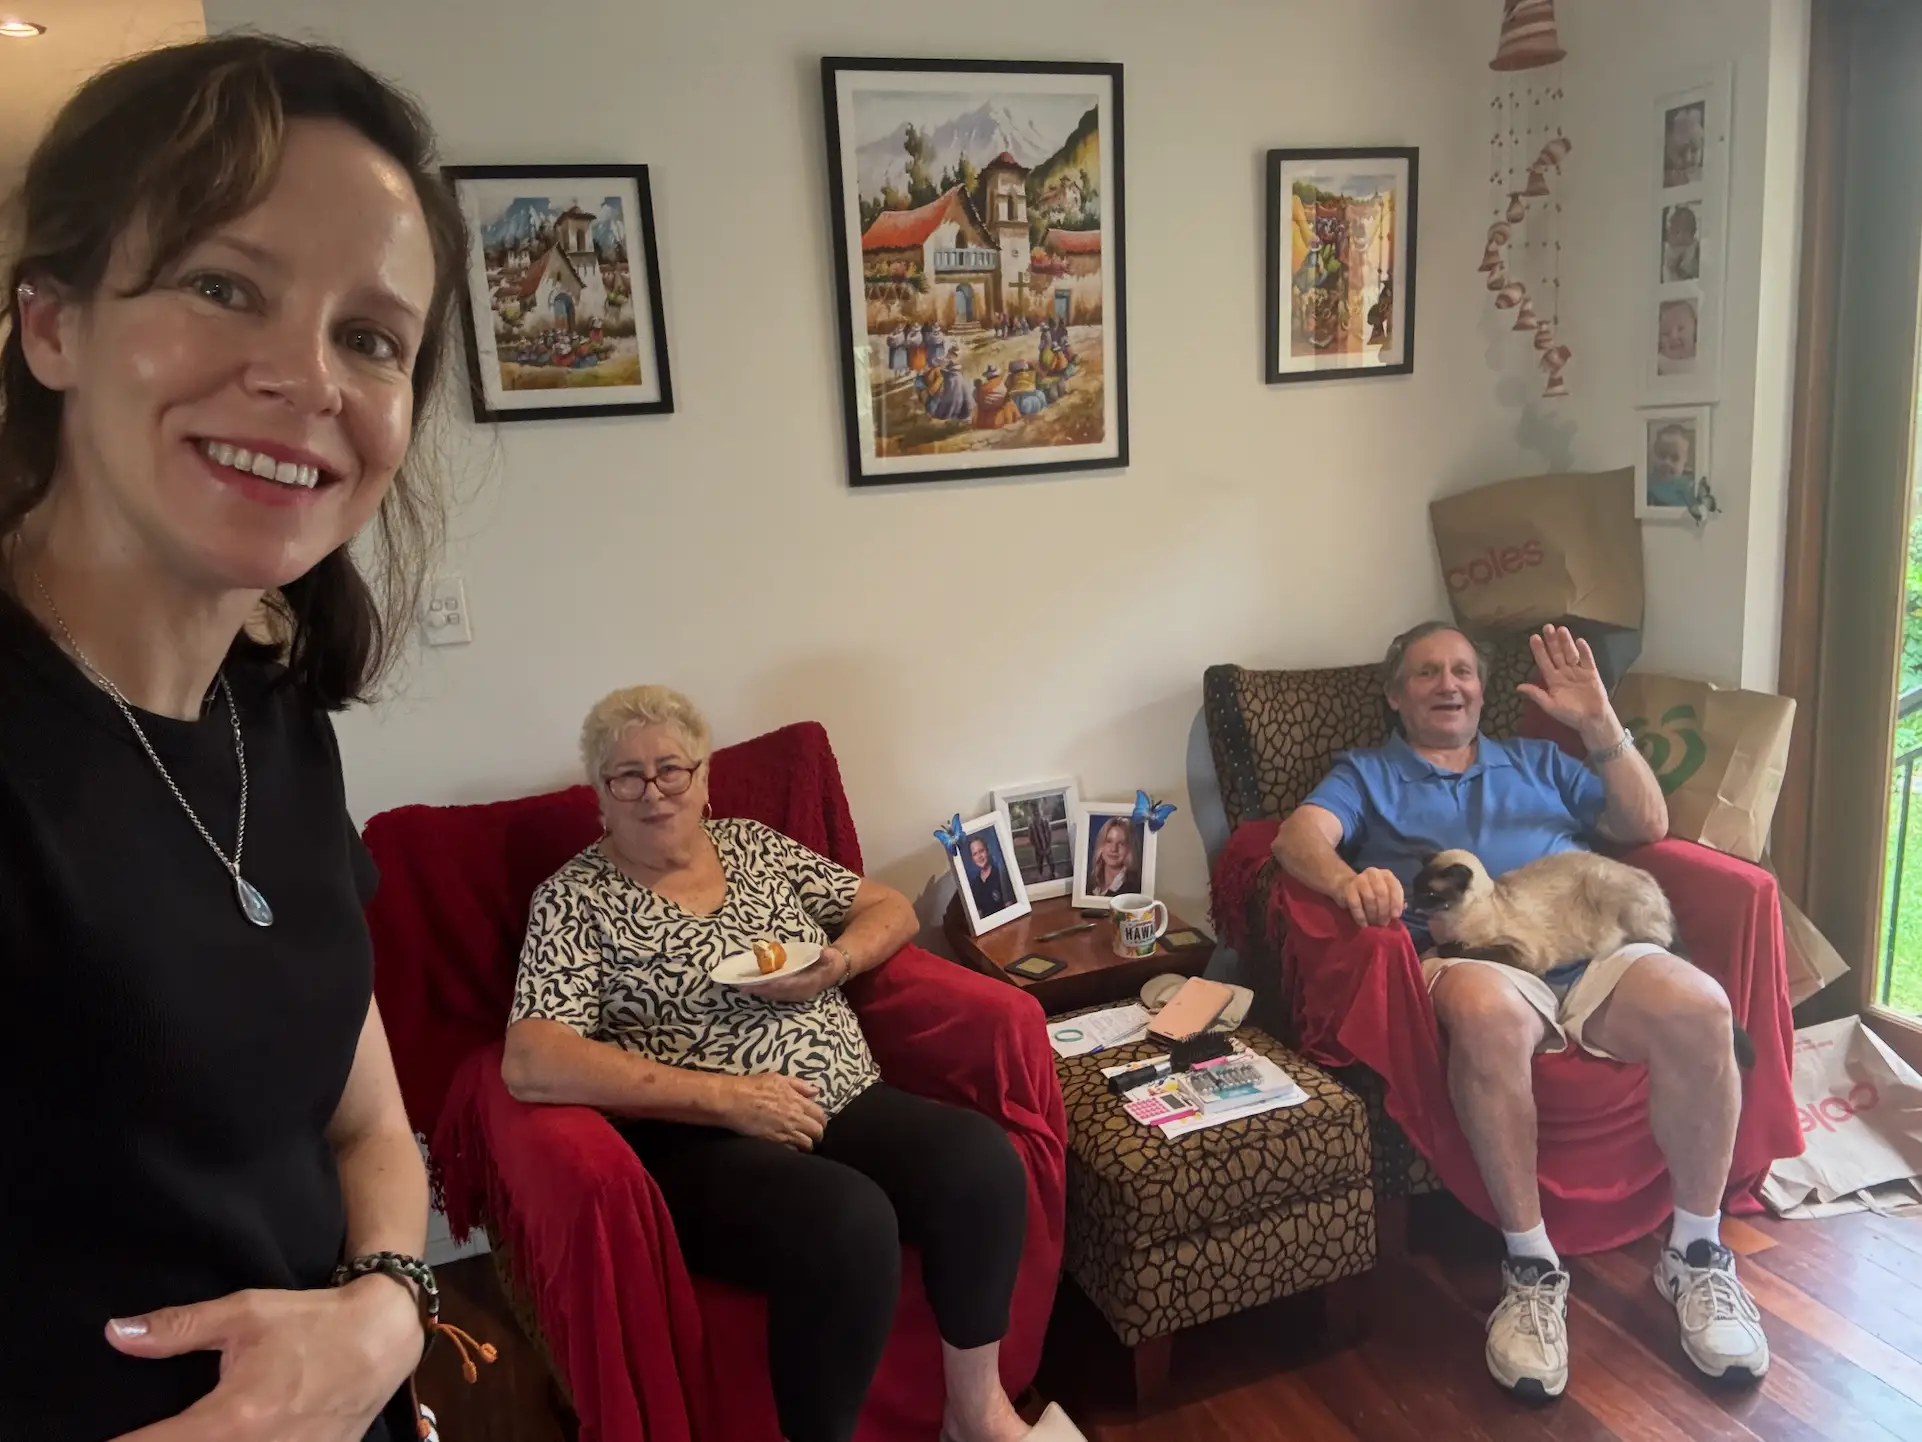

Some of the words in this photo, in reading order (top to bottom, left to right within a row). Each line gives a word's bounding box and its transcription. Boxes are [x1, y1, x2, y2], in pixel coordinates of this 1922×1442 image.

[1446, 540, 1544, 592] coles
[1125, 923, 1156, 940] HAWA
[1797, 1081, 1879, 1133] cole
